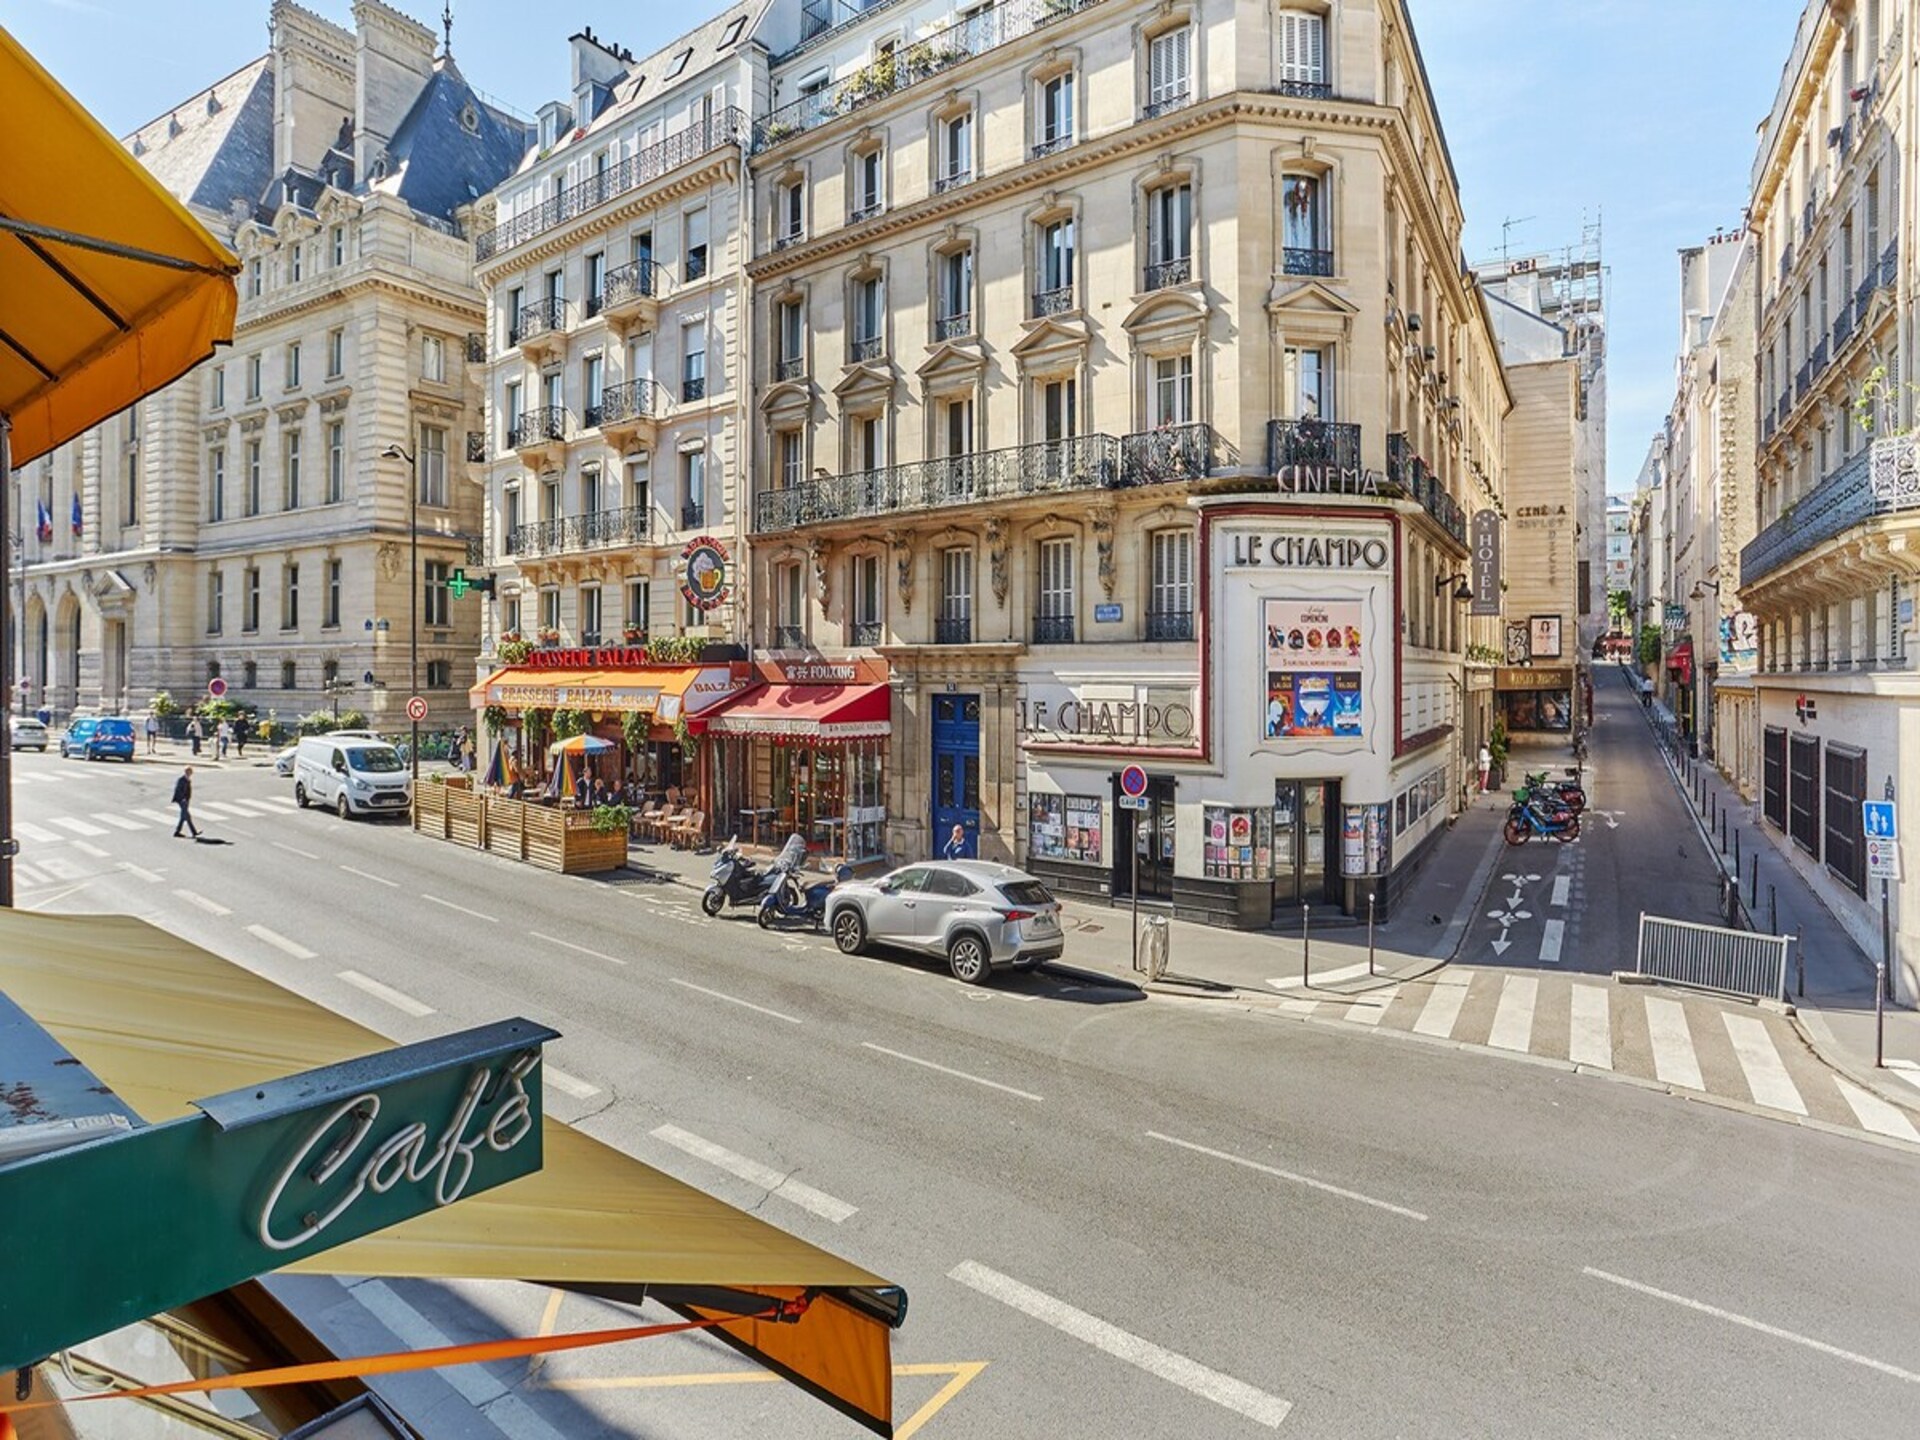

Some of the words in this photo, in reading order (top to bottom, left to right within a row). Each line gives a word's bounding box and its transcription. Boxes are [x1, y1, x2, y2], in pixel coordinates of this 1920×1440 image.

[1277, 465, 1379, 495] CINEMA
[1234, 535, 1262, 565] LE
[1270, 536, 1389, 568] CHAMPO
[1478, 534, 1493, 601] HOTEL
[811, 665, 855, 680] FOUXING
[502, 687, 560, 702] BRASSERIE
[566, 688, 613, 704] BALZAR
[1020, 701, 1048, 732] LE
[1057, 701, 1194, 738] CHAMPO
[259, 1049, 542, 1250] Café
